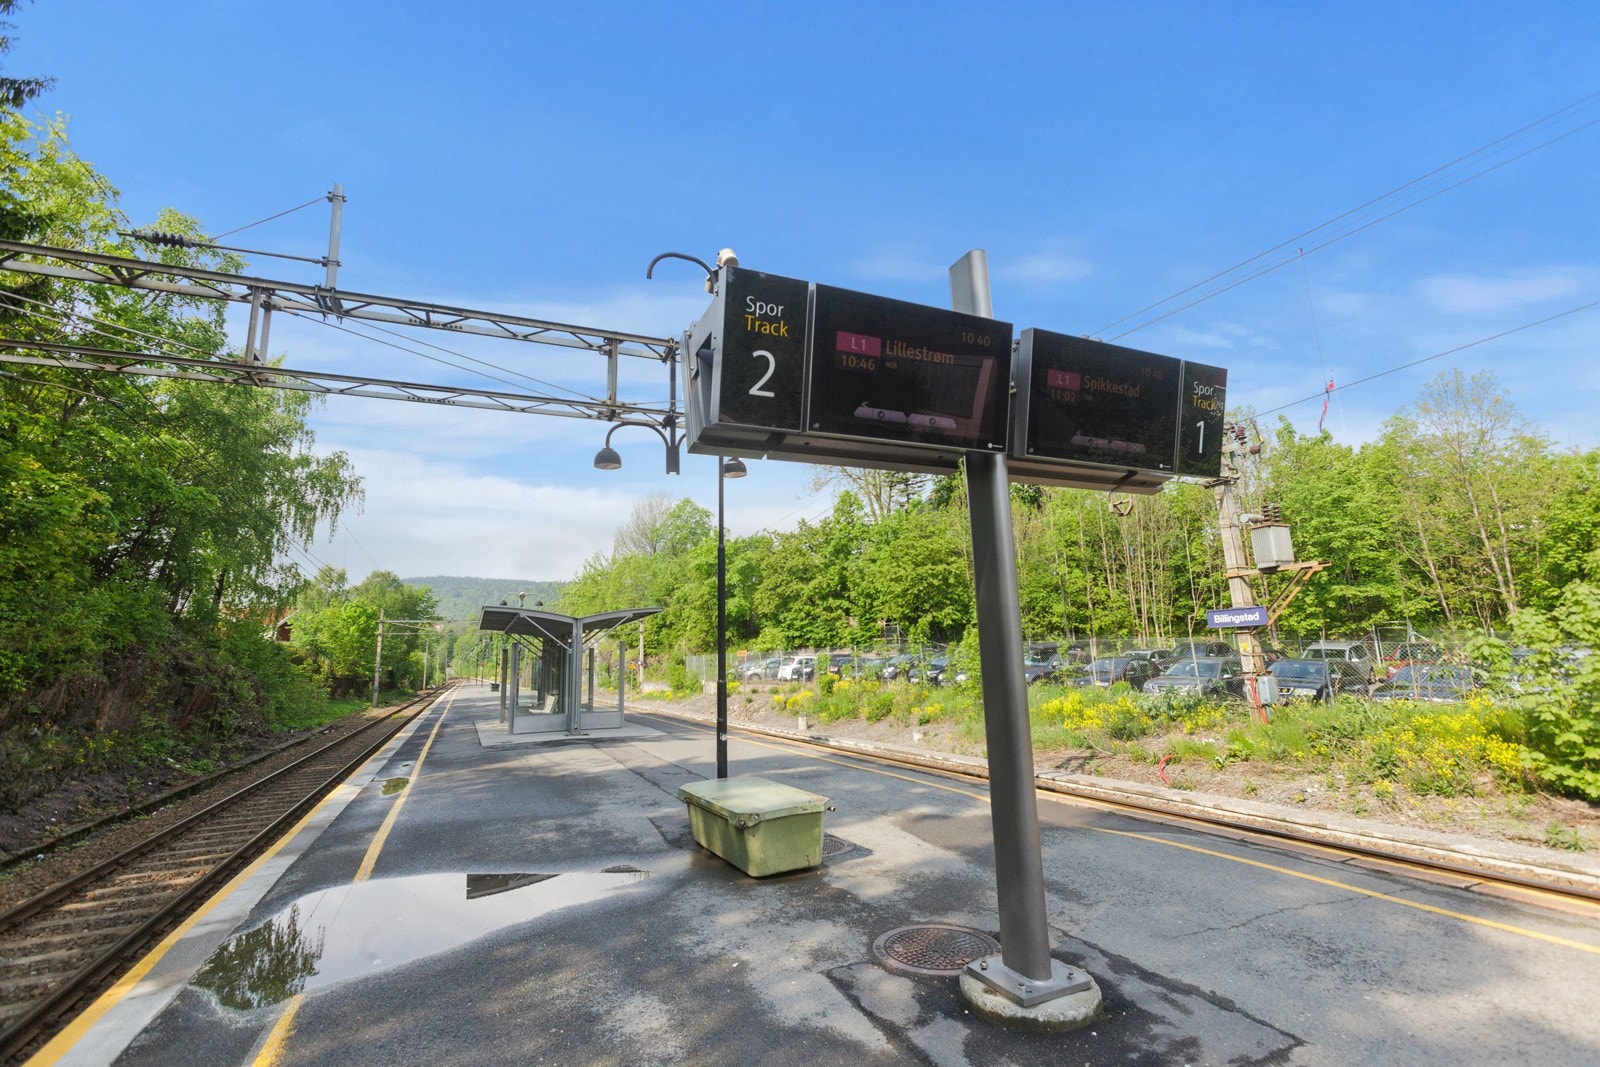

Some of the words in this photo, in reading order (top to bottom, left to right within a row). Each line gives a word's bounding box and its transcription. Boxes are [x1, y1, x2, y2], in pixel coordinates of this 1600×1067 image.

[745, 295, 784, 317] Spor
[744, 314, 789, 337] Track
[841, 354, 876, 371] 10:46
[885, 339, 954, 365] Lillestrøm
[749, 349, 776, 397] 2
[1083, 375, 1140, 398] Spikkestad
[1193, 381, 1214, 396] Spor
[1192, 394, 1216, 411] Track
[1196, 420, 1205, 454] 1
[1213, 611, 1260, 624] Billingstad
